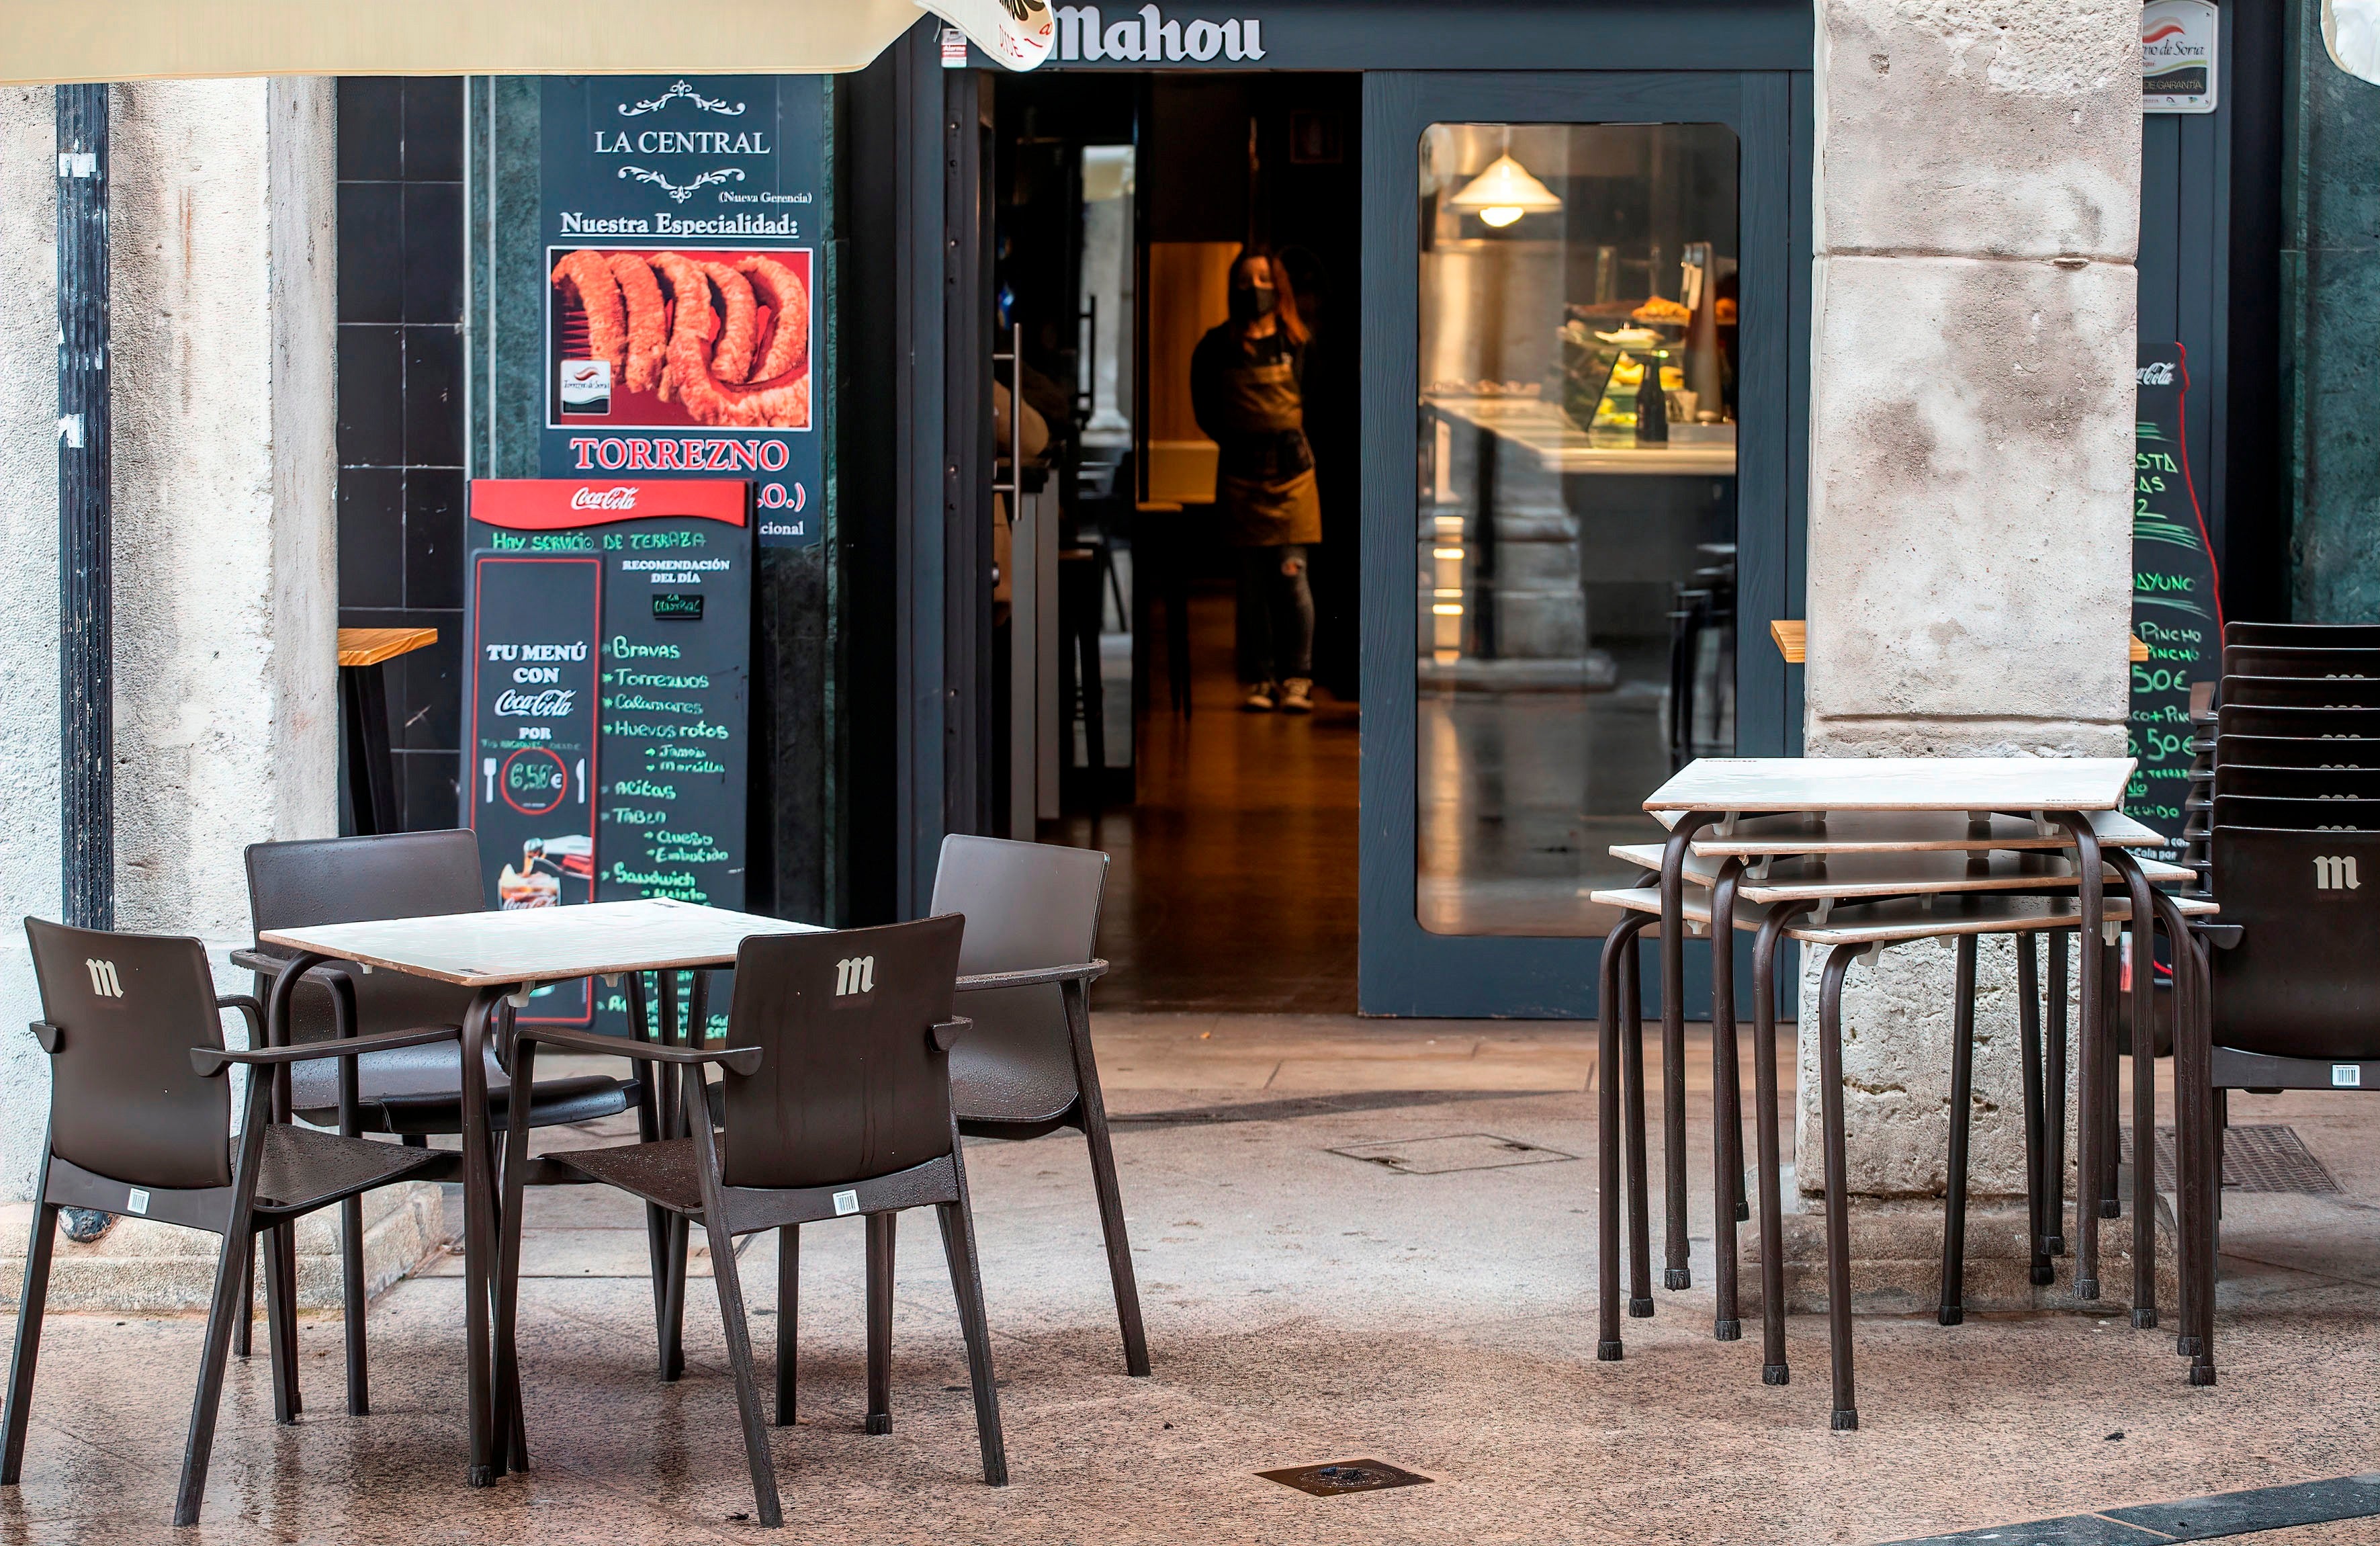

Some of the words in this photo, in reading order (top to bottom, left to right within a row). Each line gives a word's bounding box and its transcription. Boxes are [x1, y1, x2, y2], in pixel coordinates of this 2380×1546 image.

[1047, 3, 1266, 62] Mahou
[2160, 39, 2172, 55] de
[2173, 41, 2204, 56] Soria
[594, 131, 633, 154] LA
[638, 131, 771, 155] CENTRAL
[718, 191, 758, 203] (Nueva
[760, 191, 812, 204] Gerencia)
[560, 212, 649, 234] Nuestra
[655, 212, 798, 237] Especialidad:
[570, 437, 789, 471] TORREZNO
[2135, 452, 2178, 474] STA
[2135, 476, 2166, 494] AS
[570, 486, 640, 511] Coca-Cola
[757, 482, 805, 512] .O.)
[2135, 498, 2168, 520] 2
[760, 521, 804, 535] cional
[603, 533, 623, 550] DE
[630, 531, 707, 550] TERRAZA
[622, 558, 730, 570] RECOMENDACIÓN
[651, 572, 676, 583] DEL
[677, 571, 701, 583] DÍA
[2133, 572, 2197, 591] AYUNO
[486, 644, 519, 661] TU
[521, 641, 587, 661] MENÚ
[613, 636, 680, 658] Bravas
[513, 667, 560, 683] CON
[494, 689, 576, 717] Coca-Cola
[614, 693, 703, 714] Calamares
[519, 727, 552, 740] POR
[615, 720, 676, 738] Huevos
[679, 720, 730, 739] rotos
[2123, 804, 2180, 819] CLUIDO
[655, 847, 729, 863] Embutido
[2158, 850, 2177, 861] por
[613, 861, 696, 887] Sandwich
